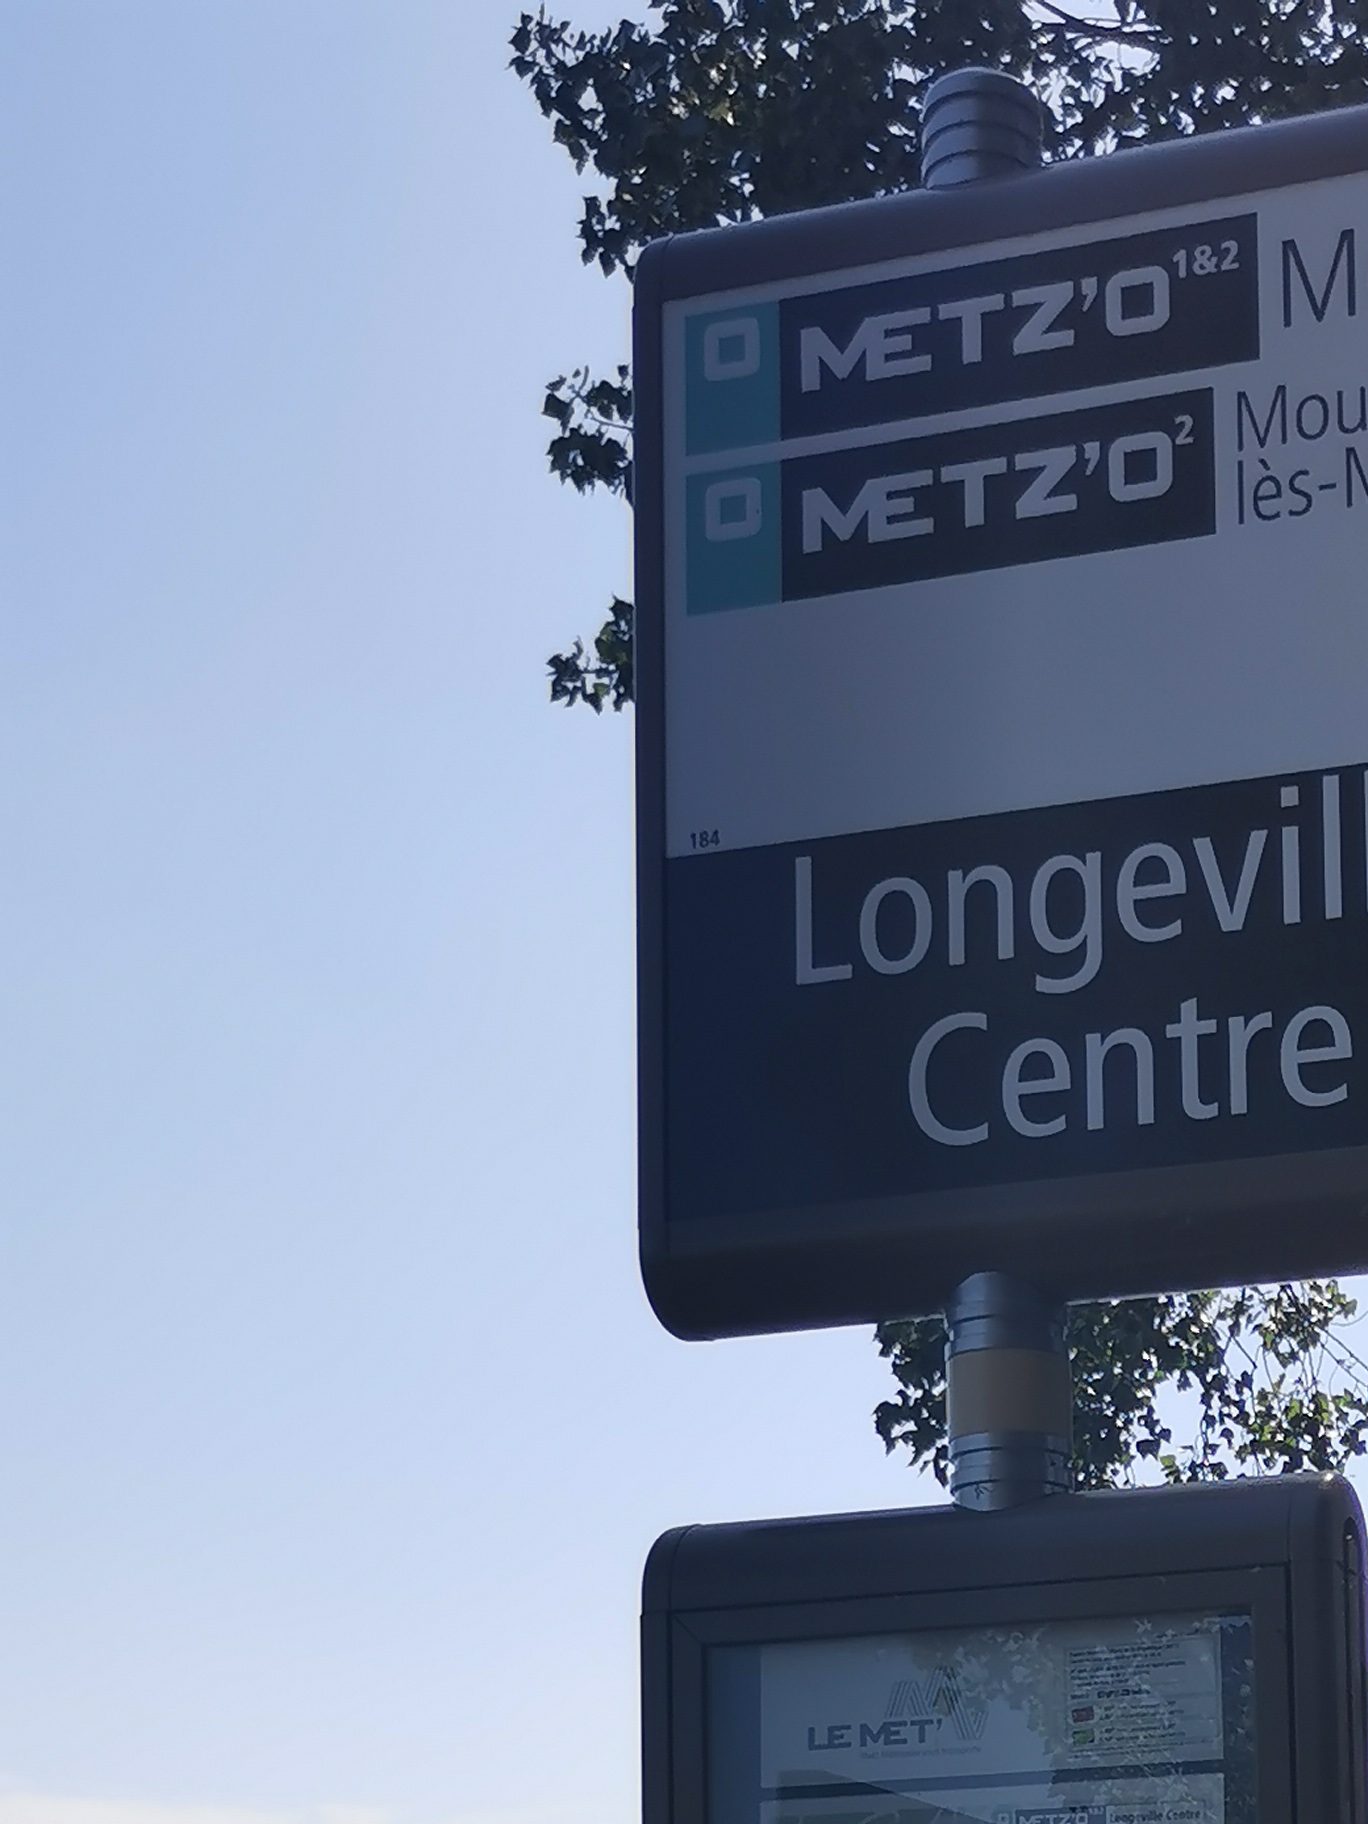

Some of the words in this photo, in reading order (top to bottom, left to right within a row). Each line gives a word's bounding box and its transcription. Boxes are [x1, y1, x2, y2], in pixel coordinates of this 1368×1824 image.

[800, 267, 1171, 393] METZ'O
[801, 431, 1173, 555] METZ'O
[690, 829, 720, 850] 184
[906, 998, 1353, 1147] Centre
[807, 1724, 852, 1751] LE
[859, 1717, 943, 1748] MET'
[1165, 1808, 1201, 1822] Centre
